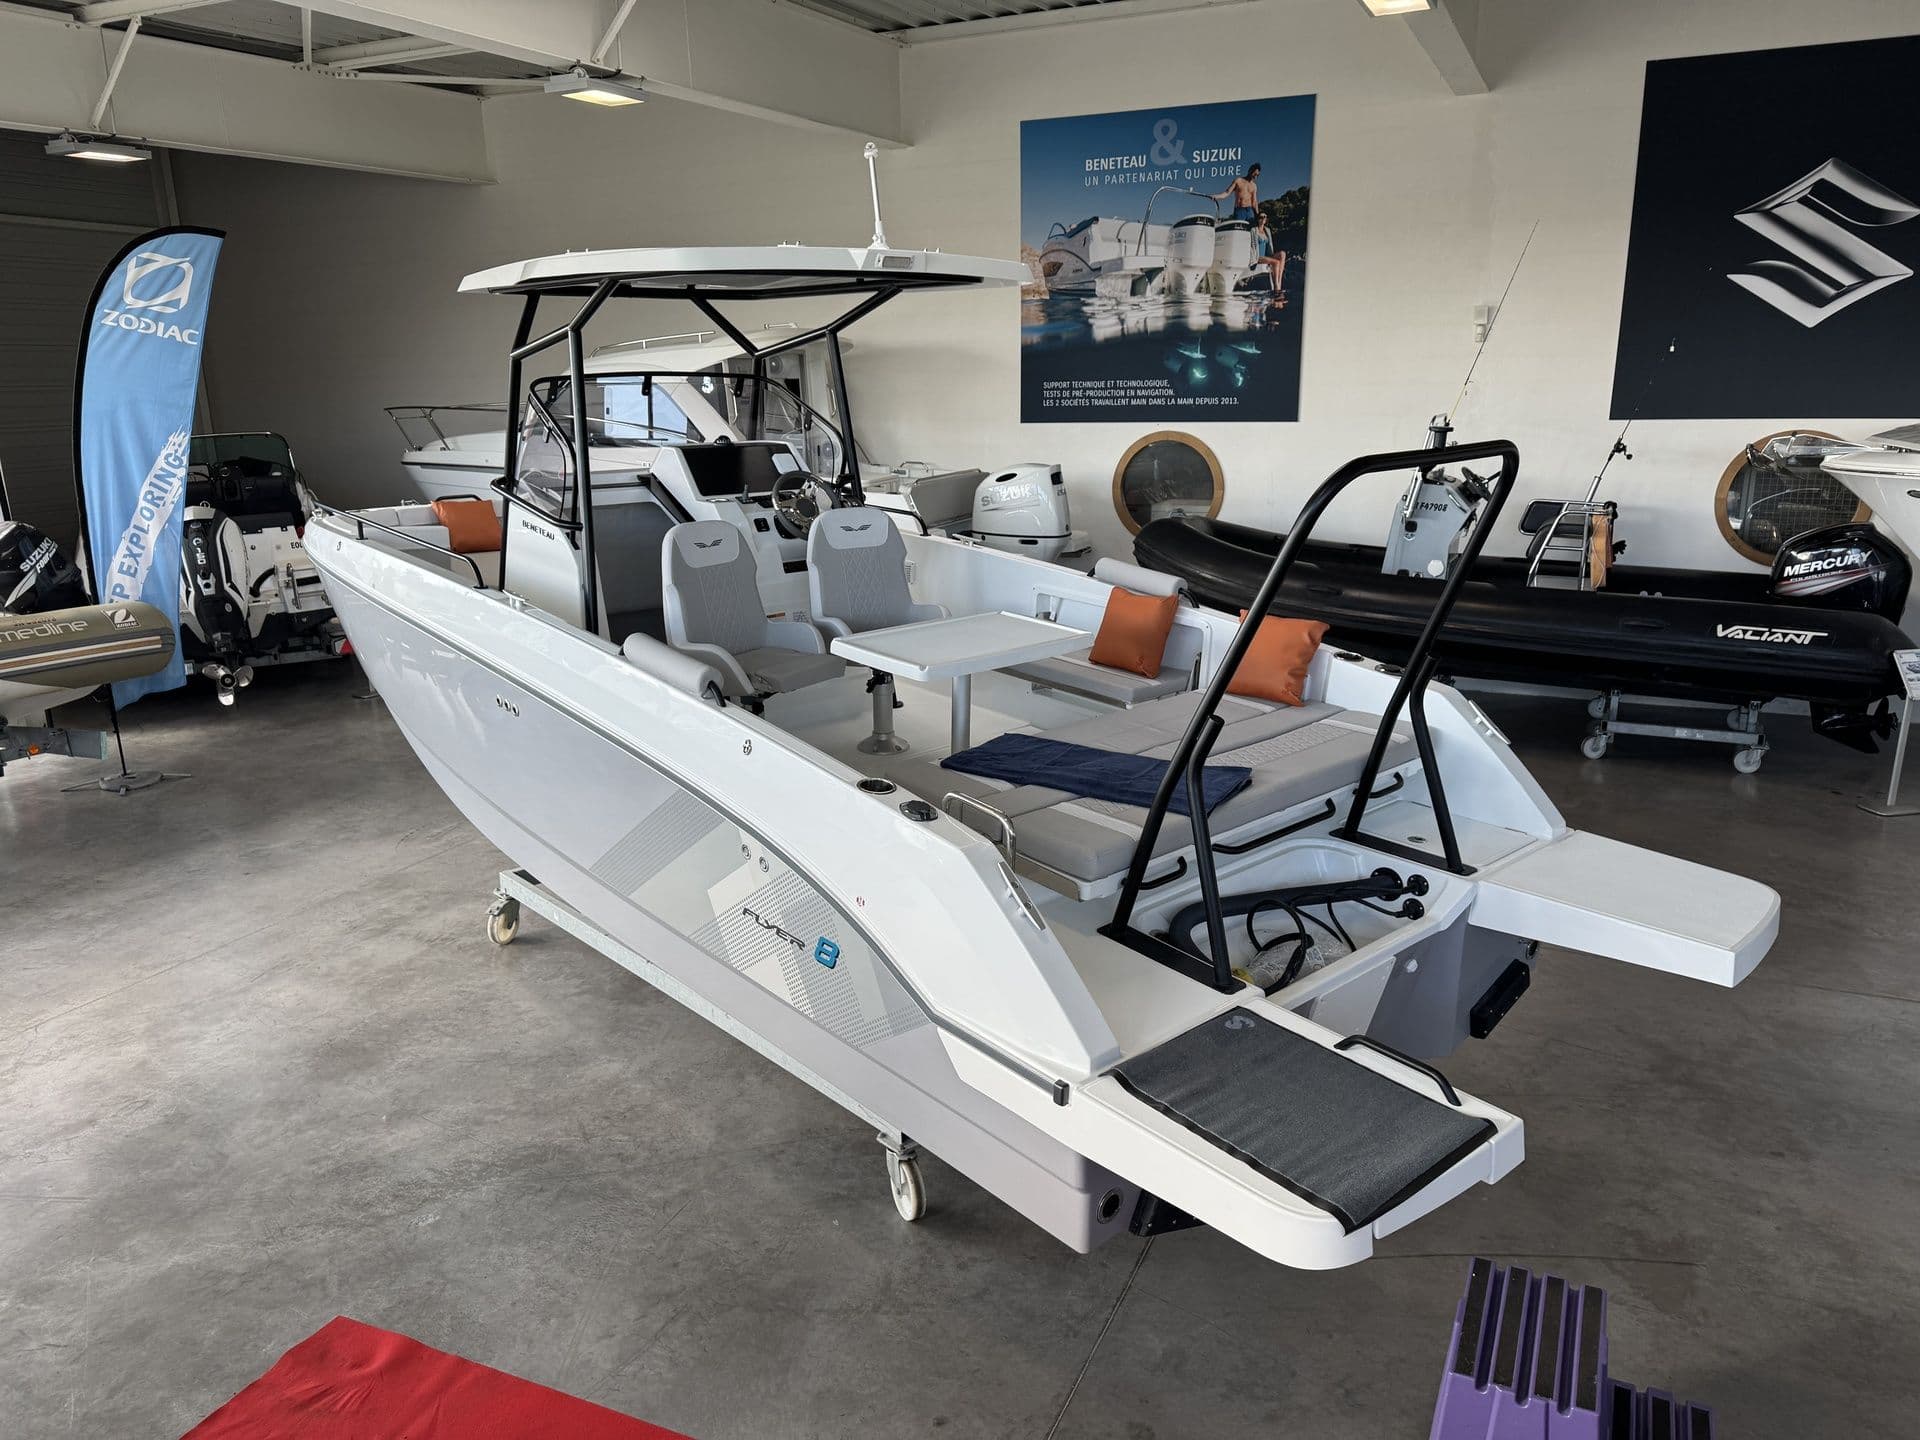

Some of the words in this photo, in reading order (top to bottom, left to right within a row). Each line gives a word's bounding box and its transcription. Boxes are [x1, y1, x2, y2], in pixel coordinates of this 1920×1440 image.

[1085, 155, 1147, 172] BENETEAU
[1150, 118, 1187, 166] &
[1192, 146, 1242, 164] SUZUKI
[1084, 175, 1099, 187] UN
[1104, 169, 1180, 185] PARTENARIAT
[1184, 167, 1206, 181] QUI
[1211, 165, 1242, 177] DURE
[101, 308, 200, 346] ZODIAC
[1043, 381, 1070, 389] SUPPORT
[1072, 380, 1105, 389] TECHNIQUE
[1107, 380, 1114, 388] ET
[1116, 379, 1170, 388] TECHNOLOGIQUE,
[1043, 390, 1061, 398] TESTS
[1071, 388, 1125, 397] PRÉ-PRODUCTION
[1136, 388, 1175, 396] NAVIGATION.
[1043, 399, 1054, 407] LES
[1055, 399, 1060, 407] 2
[1060, 398, 1090, 407] SOCIÉTÉS
[1091, 398, 1129, 406] TRAVAILLENT
[1130, 398, 1147, 406] MAIN
[1148, 397, 1166, 405] DANS
[1167, 397, 1176, 405] LA
[1177, 397, 1194, 405] MAIN
[1195, 397, 1219, 405] DEPUIS
[1220, 396, 1240, 405] 2013.
[117, 451, 186, 580] EXPLORING
[521, 519, 555, 541] BENETEAU
[19, 536, 53, 573] SUZUKI
[1783, 550, 1873, 577] MERCURY
[0, 620, 89, 643] medline
[1716, 623, 1829, 645] VALIANT
[742, 907, 806, 951] FLYER
[814, 936, 841, 970] 8
